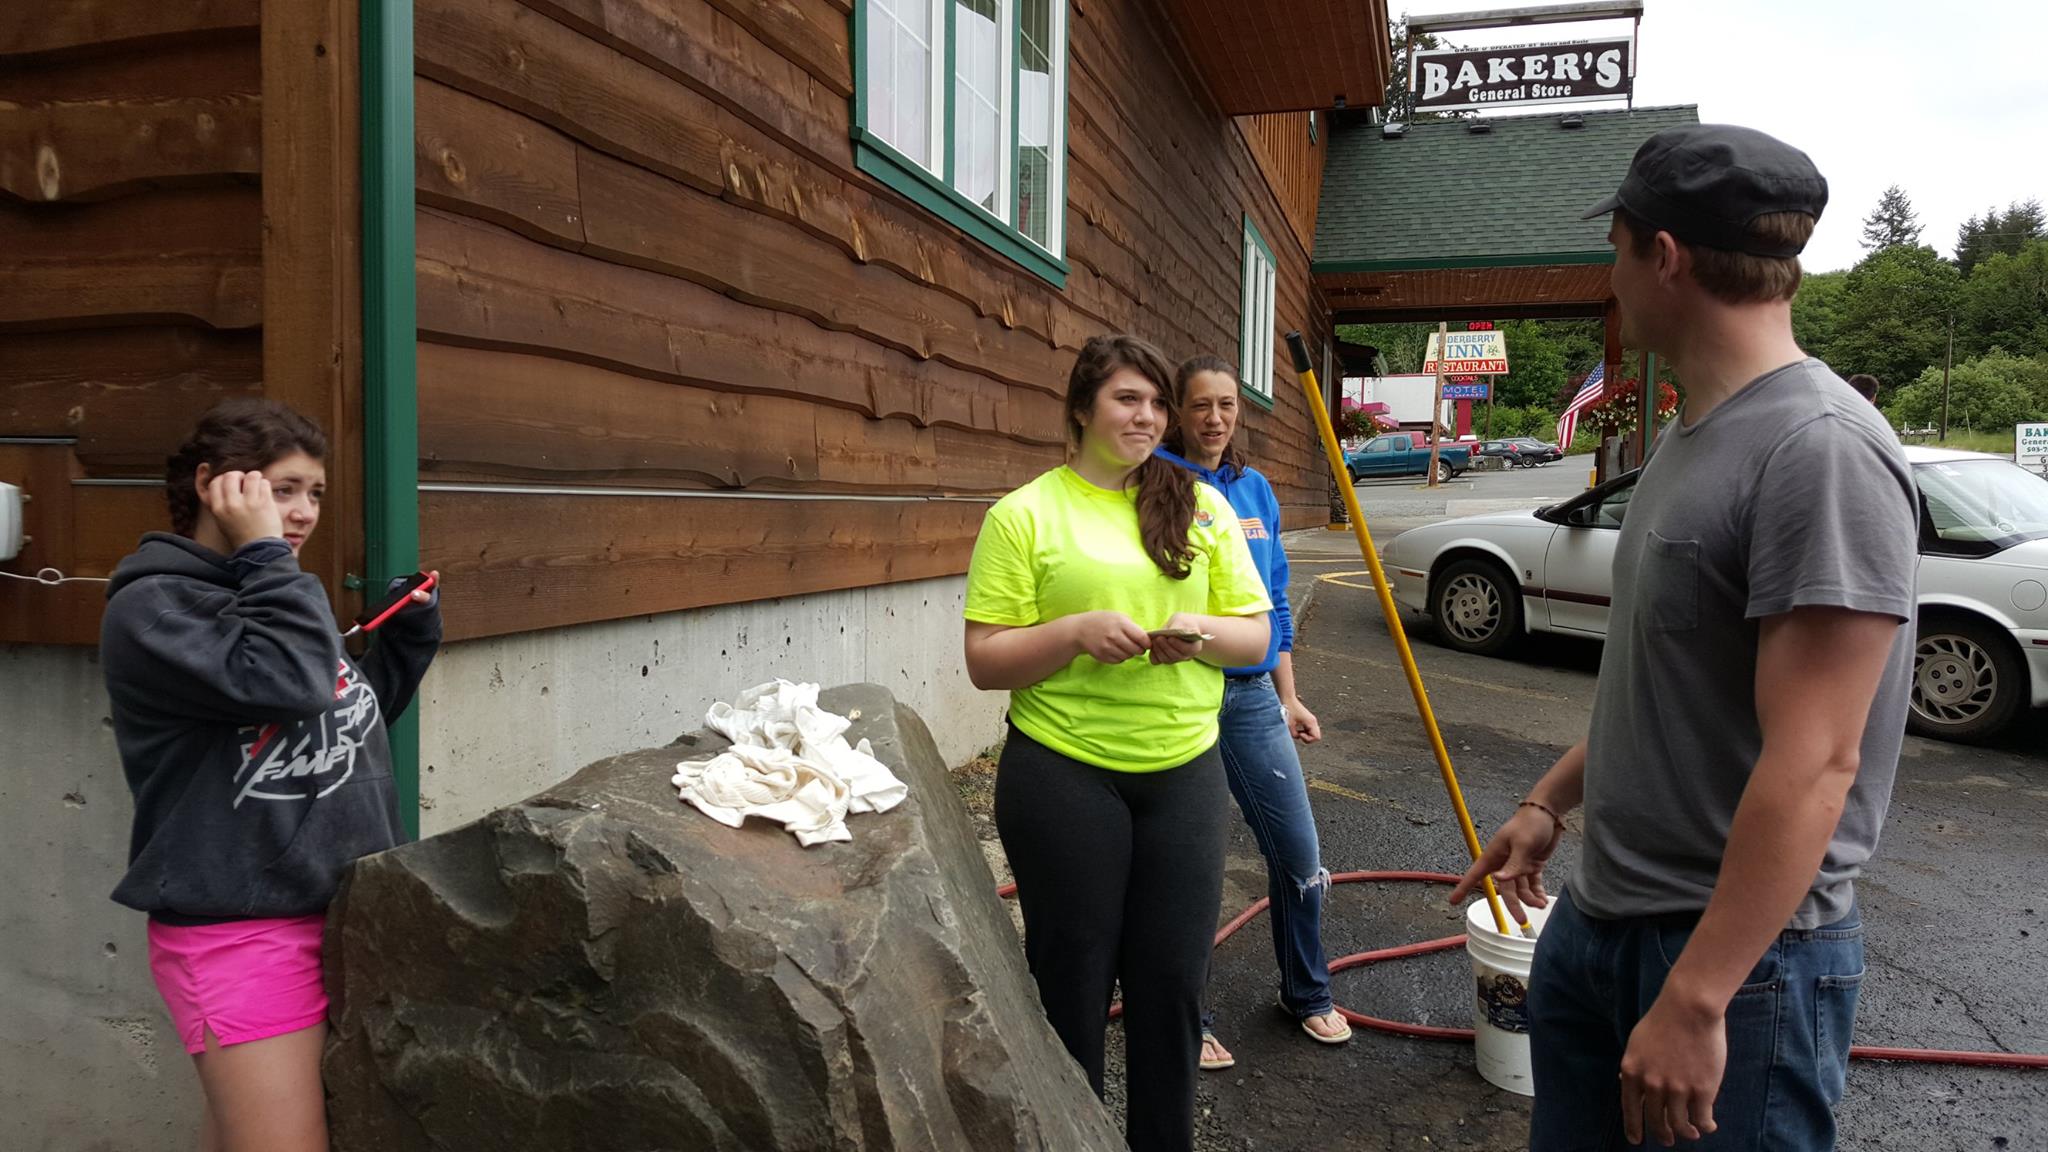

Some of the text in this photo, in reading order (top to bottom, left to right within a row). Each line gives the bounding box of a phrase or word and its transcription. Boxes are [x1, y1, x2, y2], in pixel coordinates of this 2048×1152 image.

[1422, 49, 1621, 100] BAKER'S
[1469, 82, 1572, 102] General Store
[1447, 344, 1485, 358] INN
